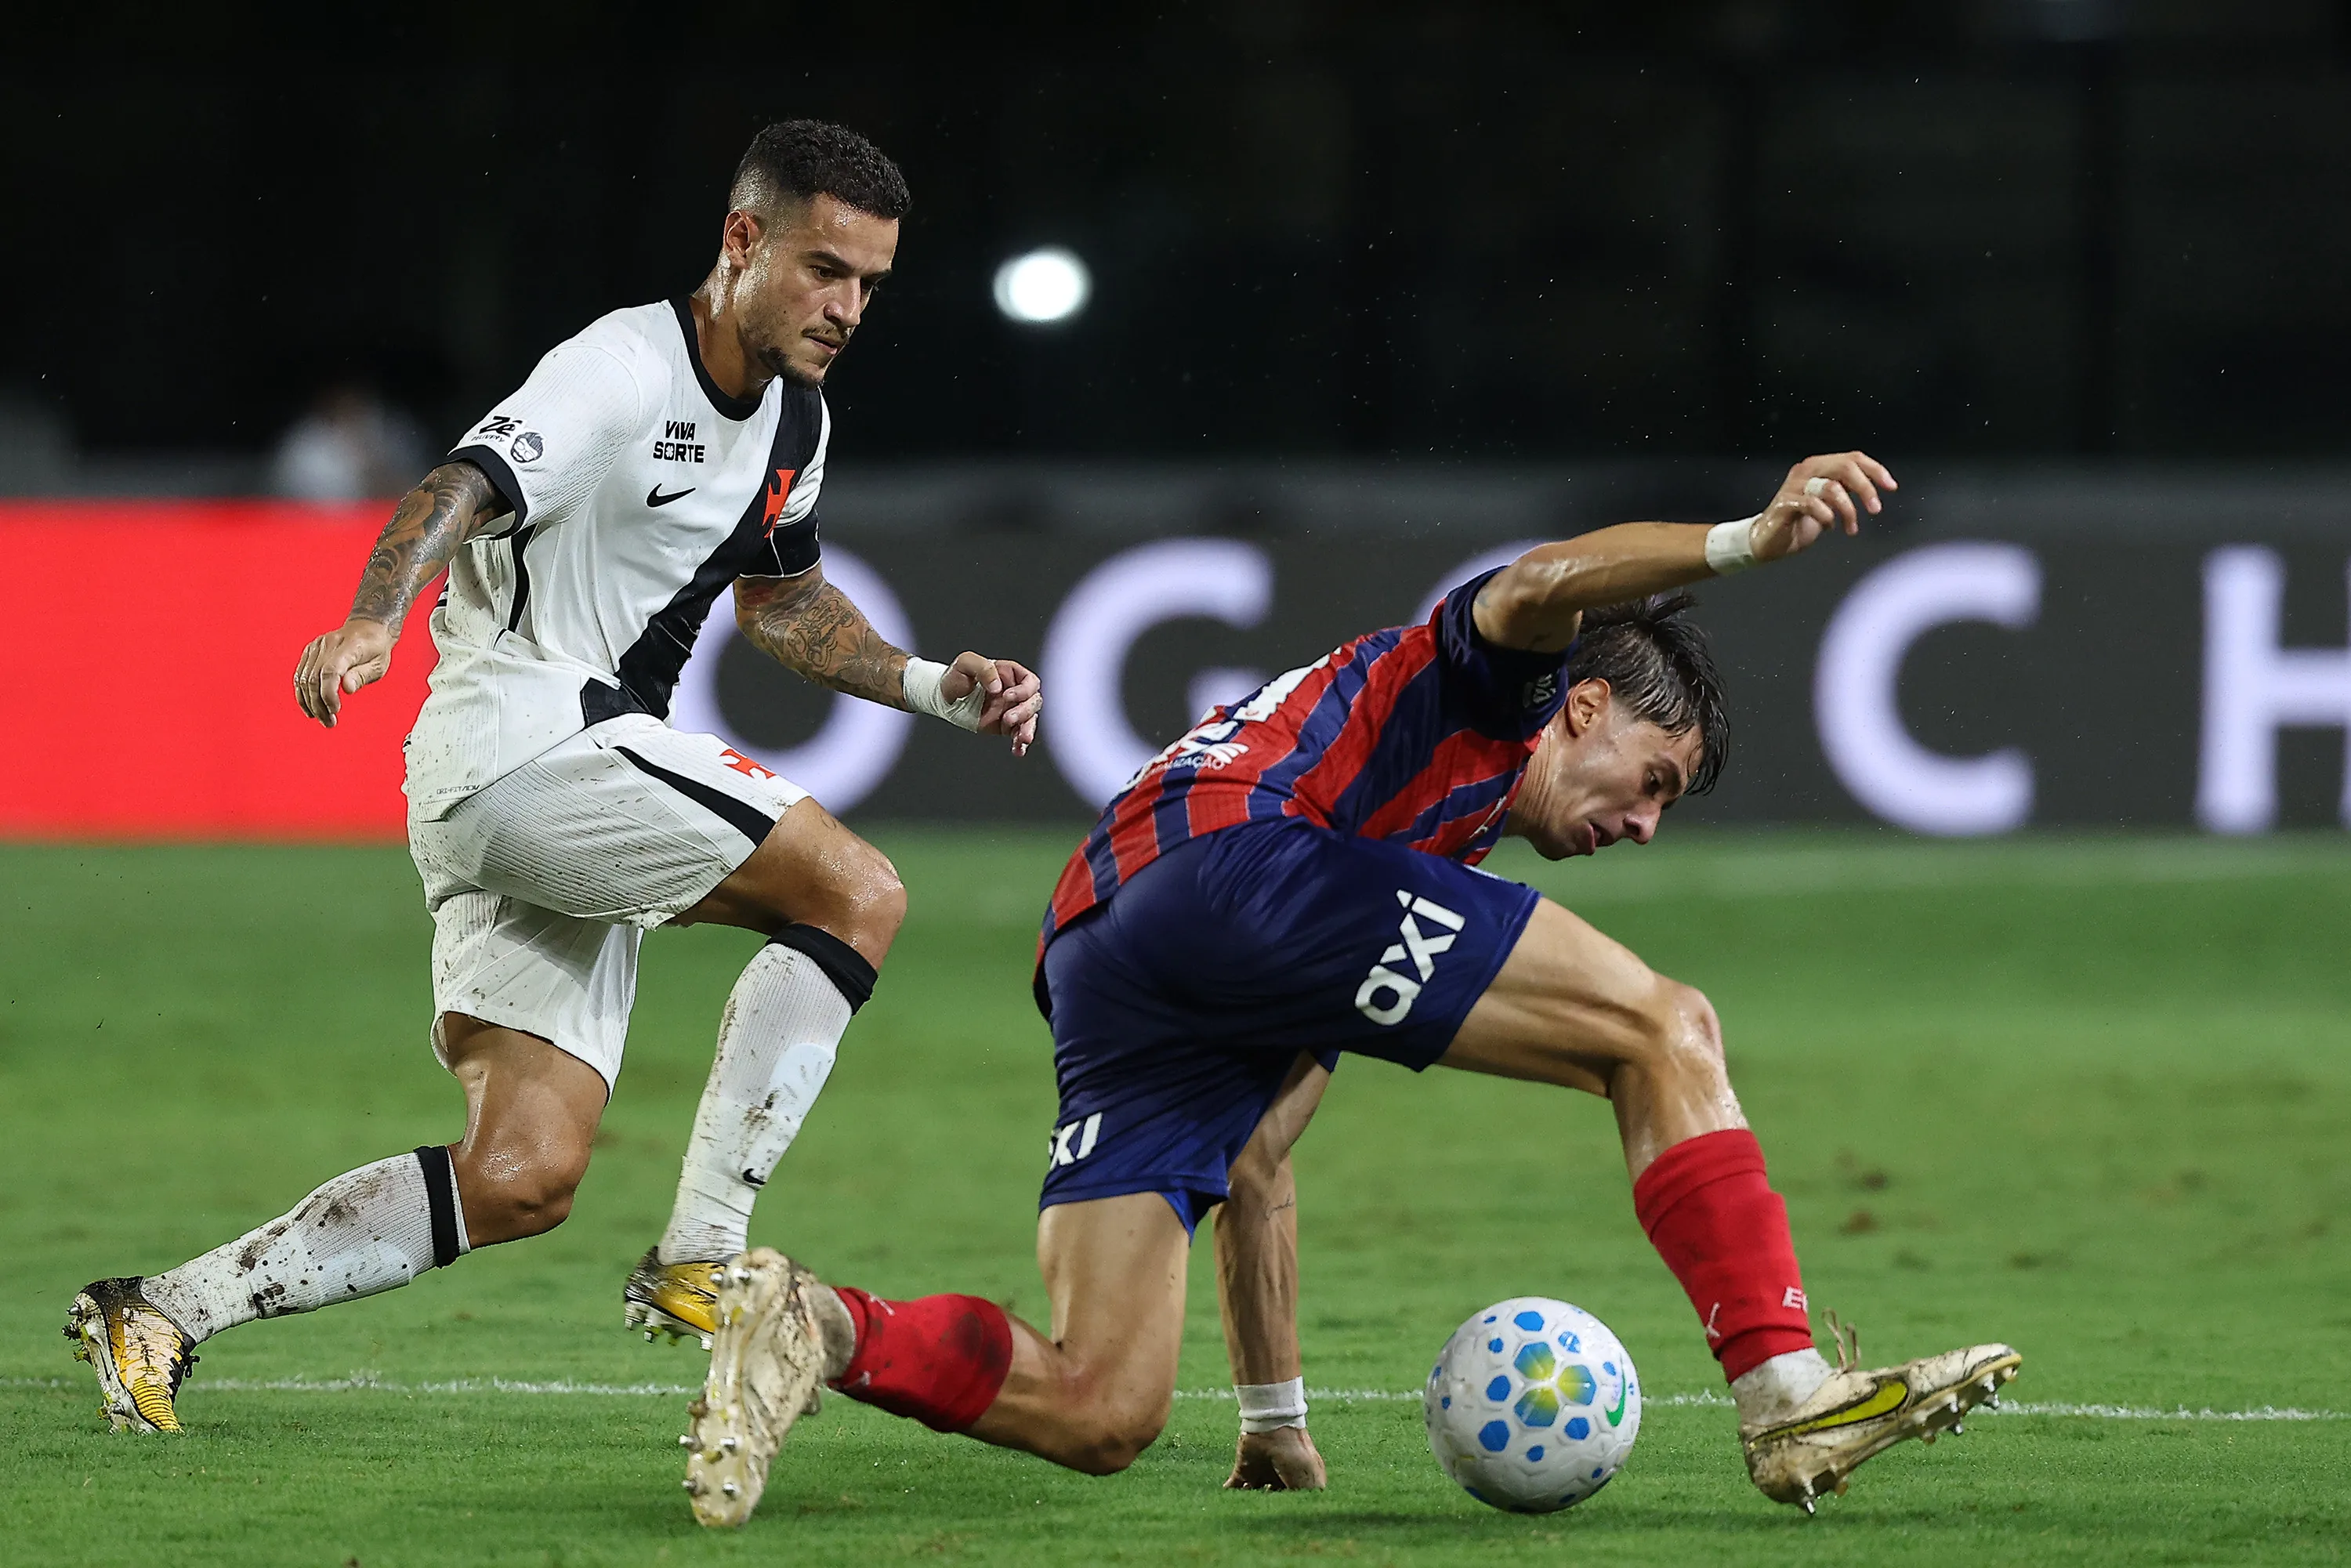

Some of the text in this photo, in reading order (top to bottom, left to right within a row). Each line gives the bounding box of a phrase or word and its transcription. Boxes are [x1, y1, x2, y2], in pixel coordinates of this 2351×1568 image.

[480, 416, 523, 437] Zé
[665, 420, 696, 441] VIVA
[653, 441, 705, 463] SORTE
[1354, 889, 1465, 1026] axi
[1049, 1112, 1103, 1171] xi
